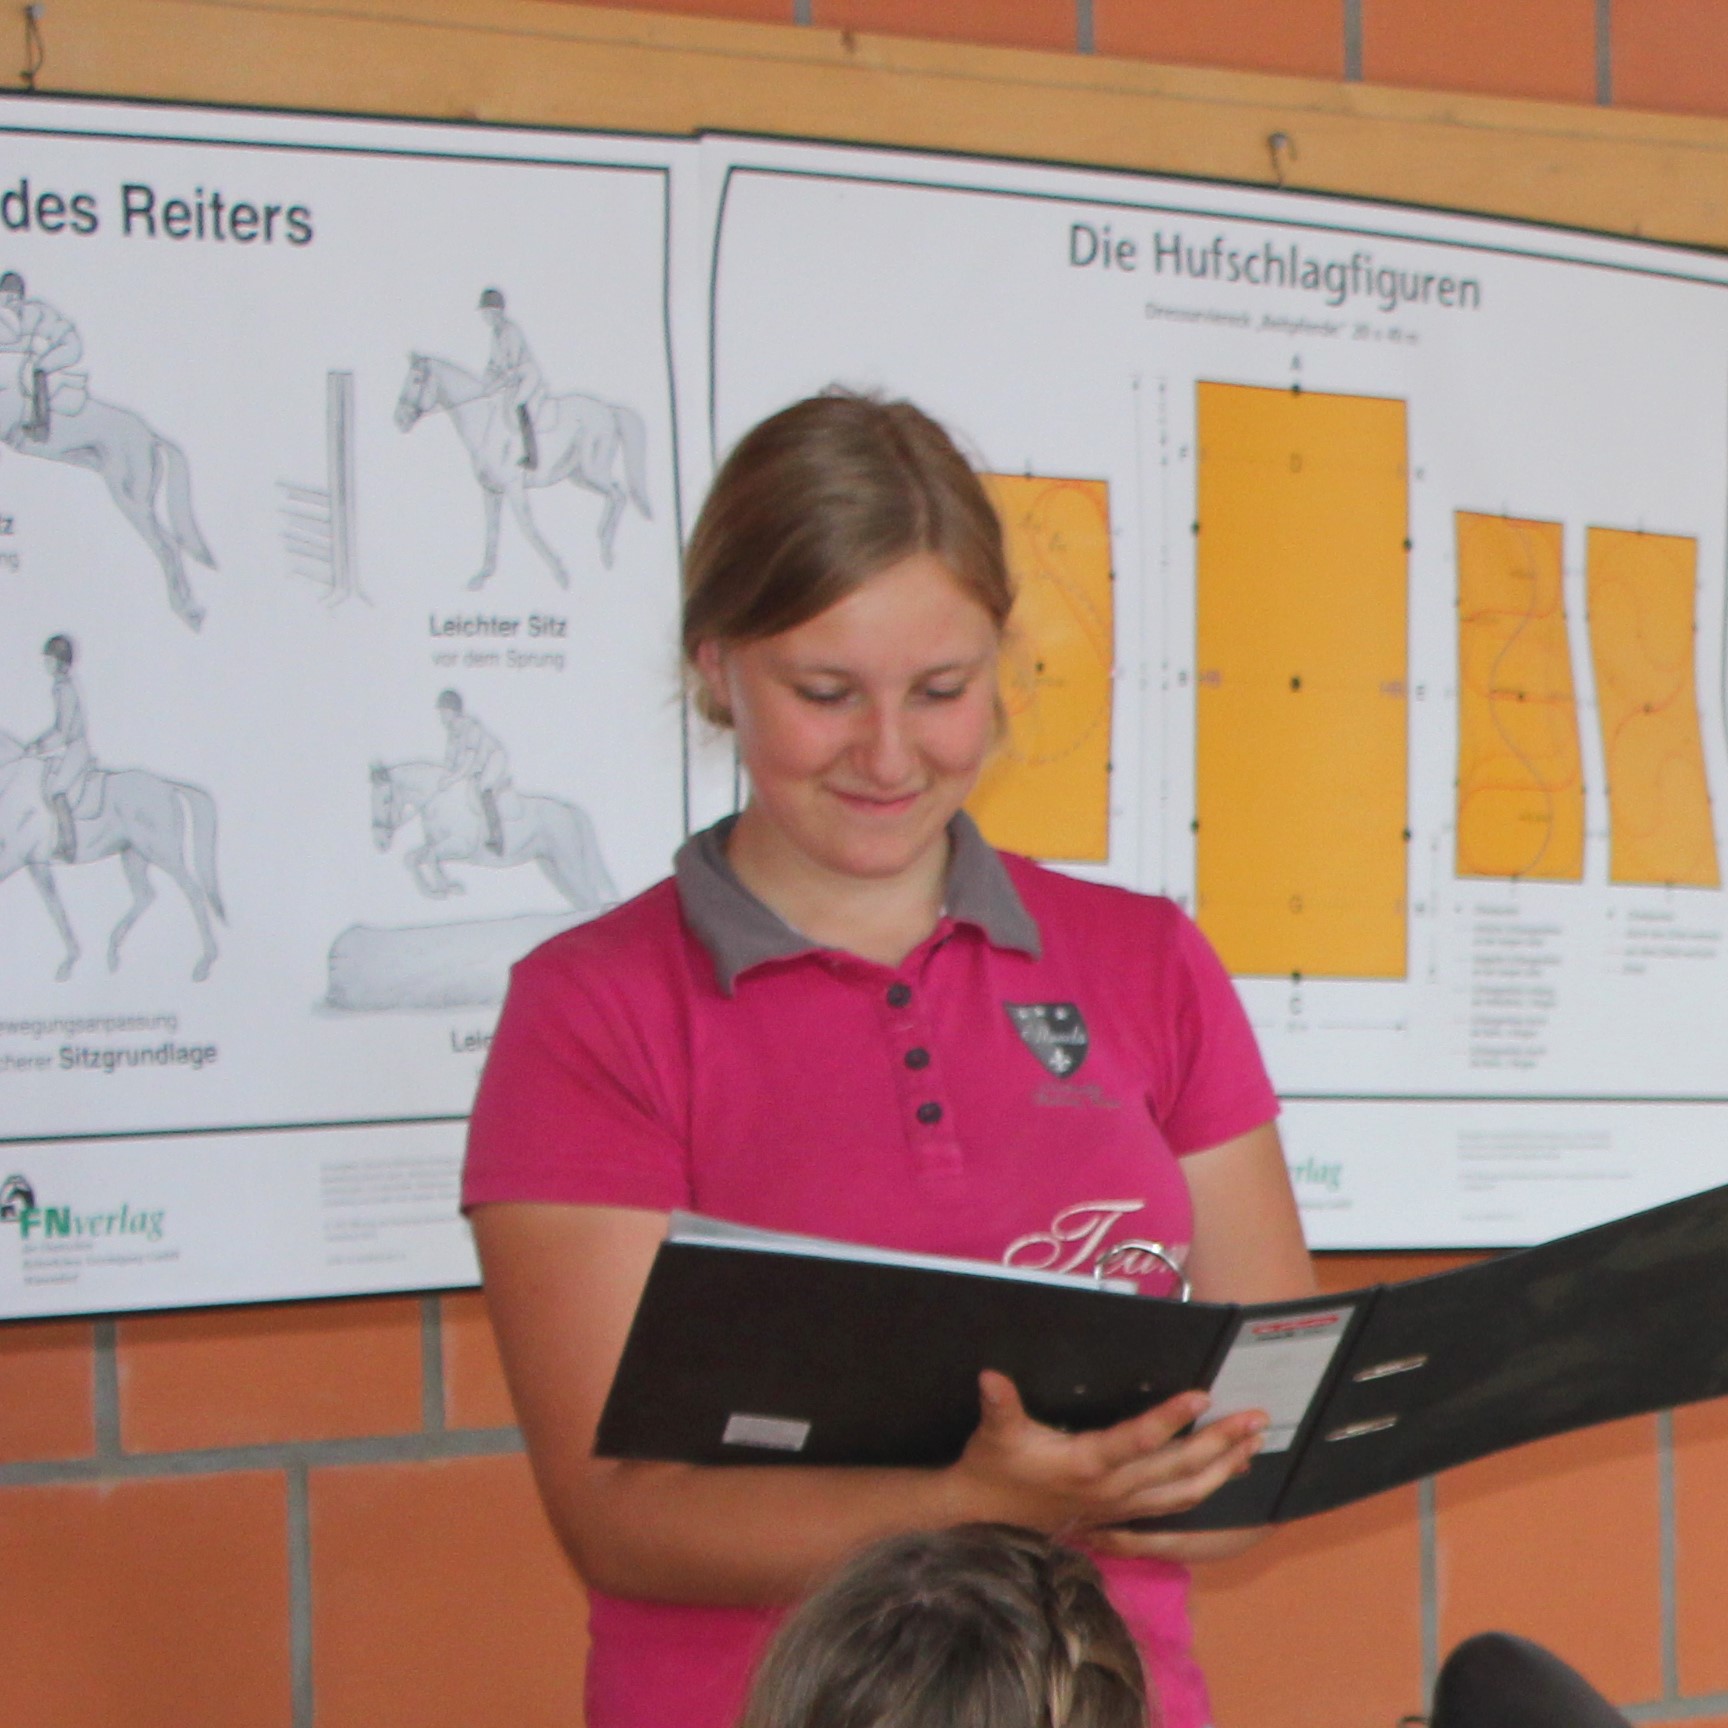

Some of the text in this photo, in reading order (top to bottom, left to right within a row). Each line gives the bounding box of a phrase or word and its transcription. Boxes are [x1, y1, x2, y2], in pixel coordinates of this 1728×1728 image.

[1, 178, 314, 246] des Reiters
[1069, 223, 1481, 311] Die Hufschlagfiguren
[429, 612, 567, 638] Leichter Sitz
[59, 1043, 217, 1073] Sitzgrundlage
